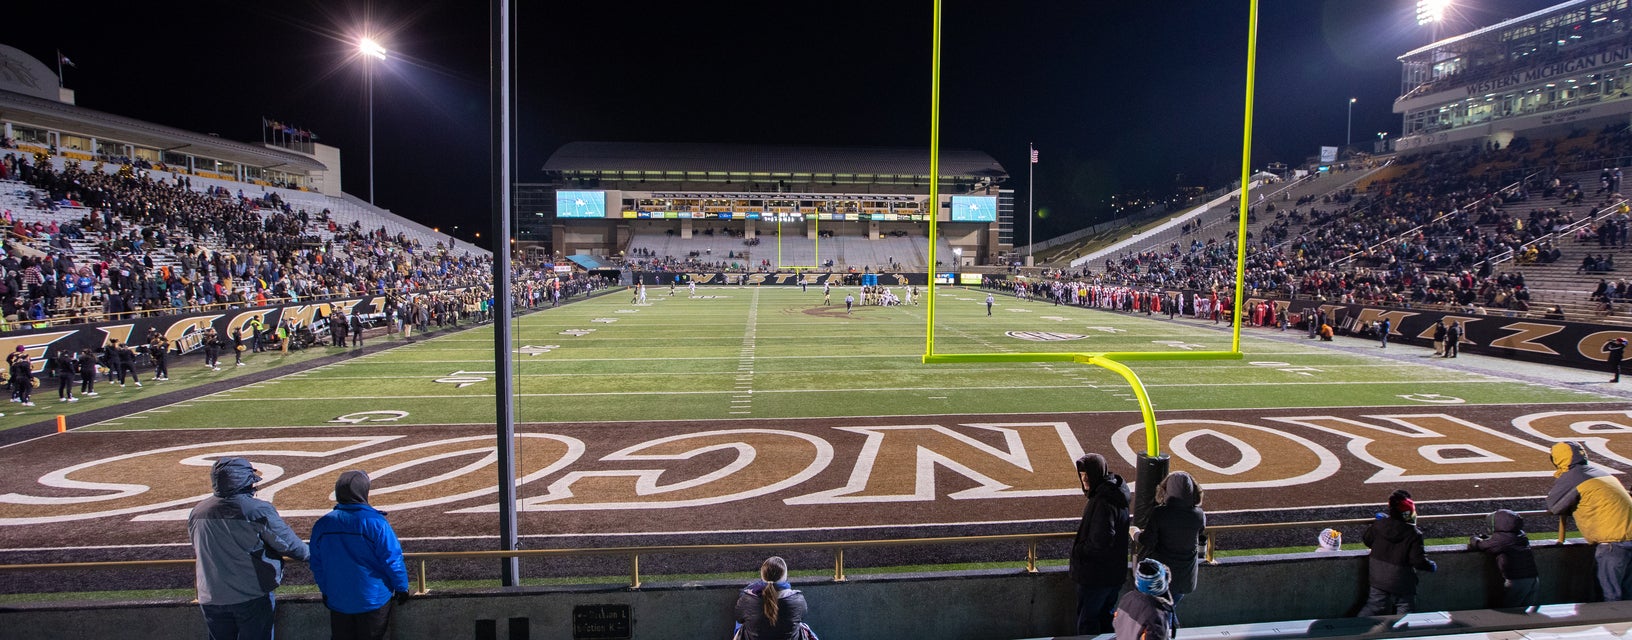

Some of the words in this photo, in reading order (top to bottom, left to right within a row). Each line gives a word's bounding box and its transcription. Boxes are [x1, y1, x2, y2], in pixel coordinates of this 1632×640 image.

[1466, 73, 1520, 95] WESTERN
[1524, 55, 1597, 82] MICHIGAN
[1601, 48, 1632, 64] UNI
[686, 273, 884, 284] WESTER
